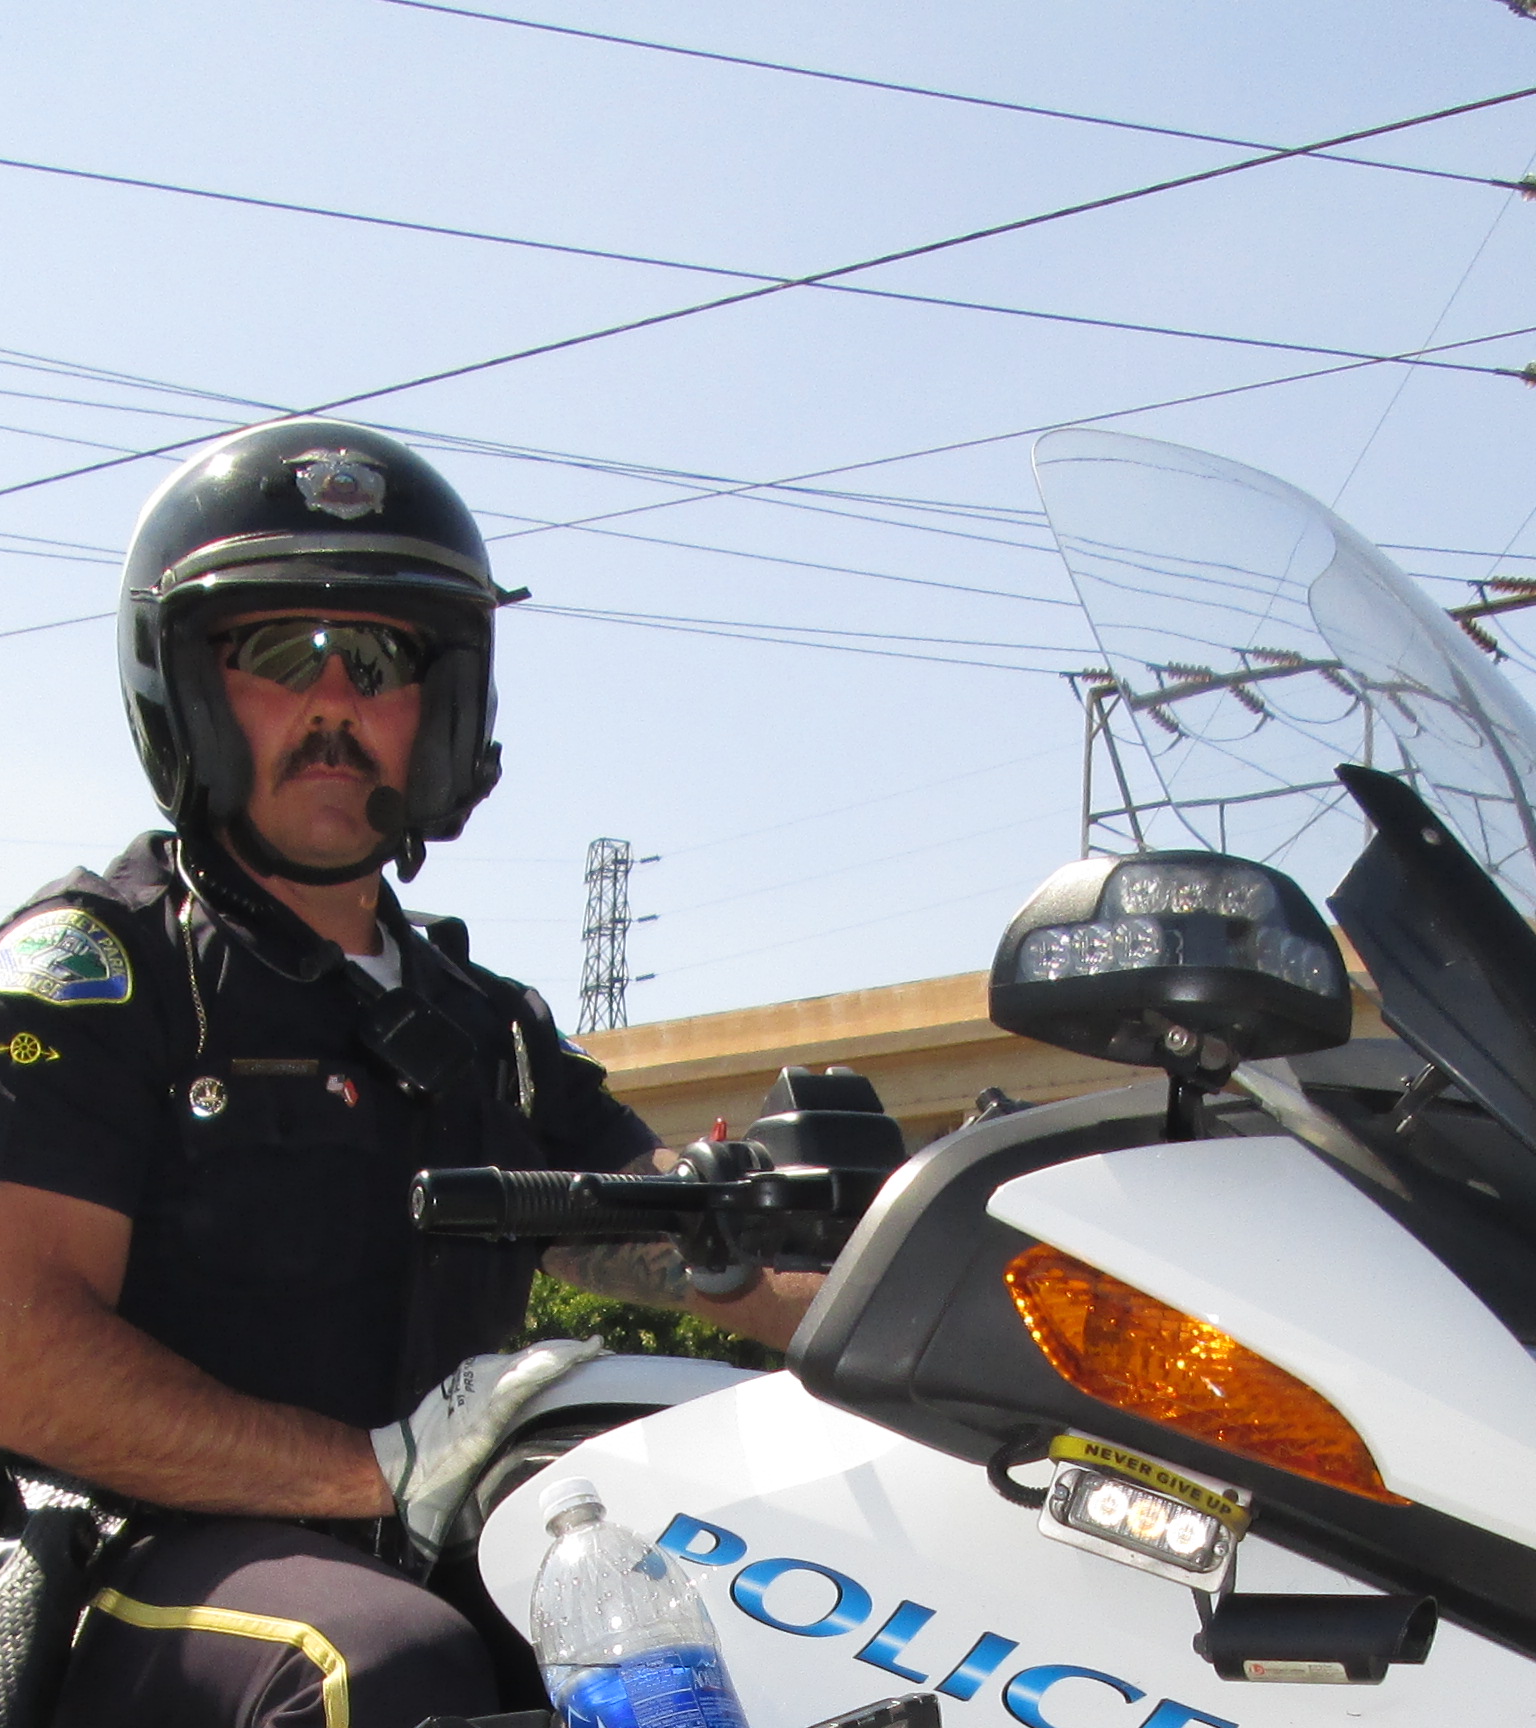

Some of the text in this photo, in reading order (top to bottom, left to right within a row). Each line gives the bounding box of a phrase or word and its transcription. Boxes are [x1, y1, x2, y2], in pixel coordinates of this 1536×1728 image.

[1084, 1443, 1232, 1515] NEVER GIVE UP
